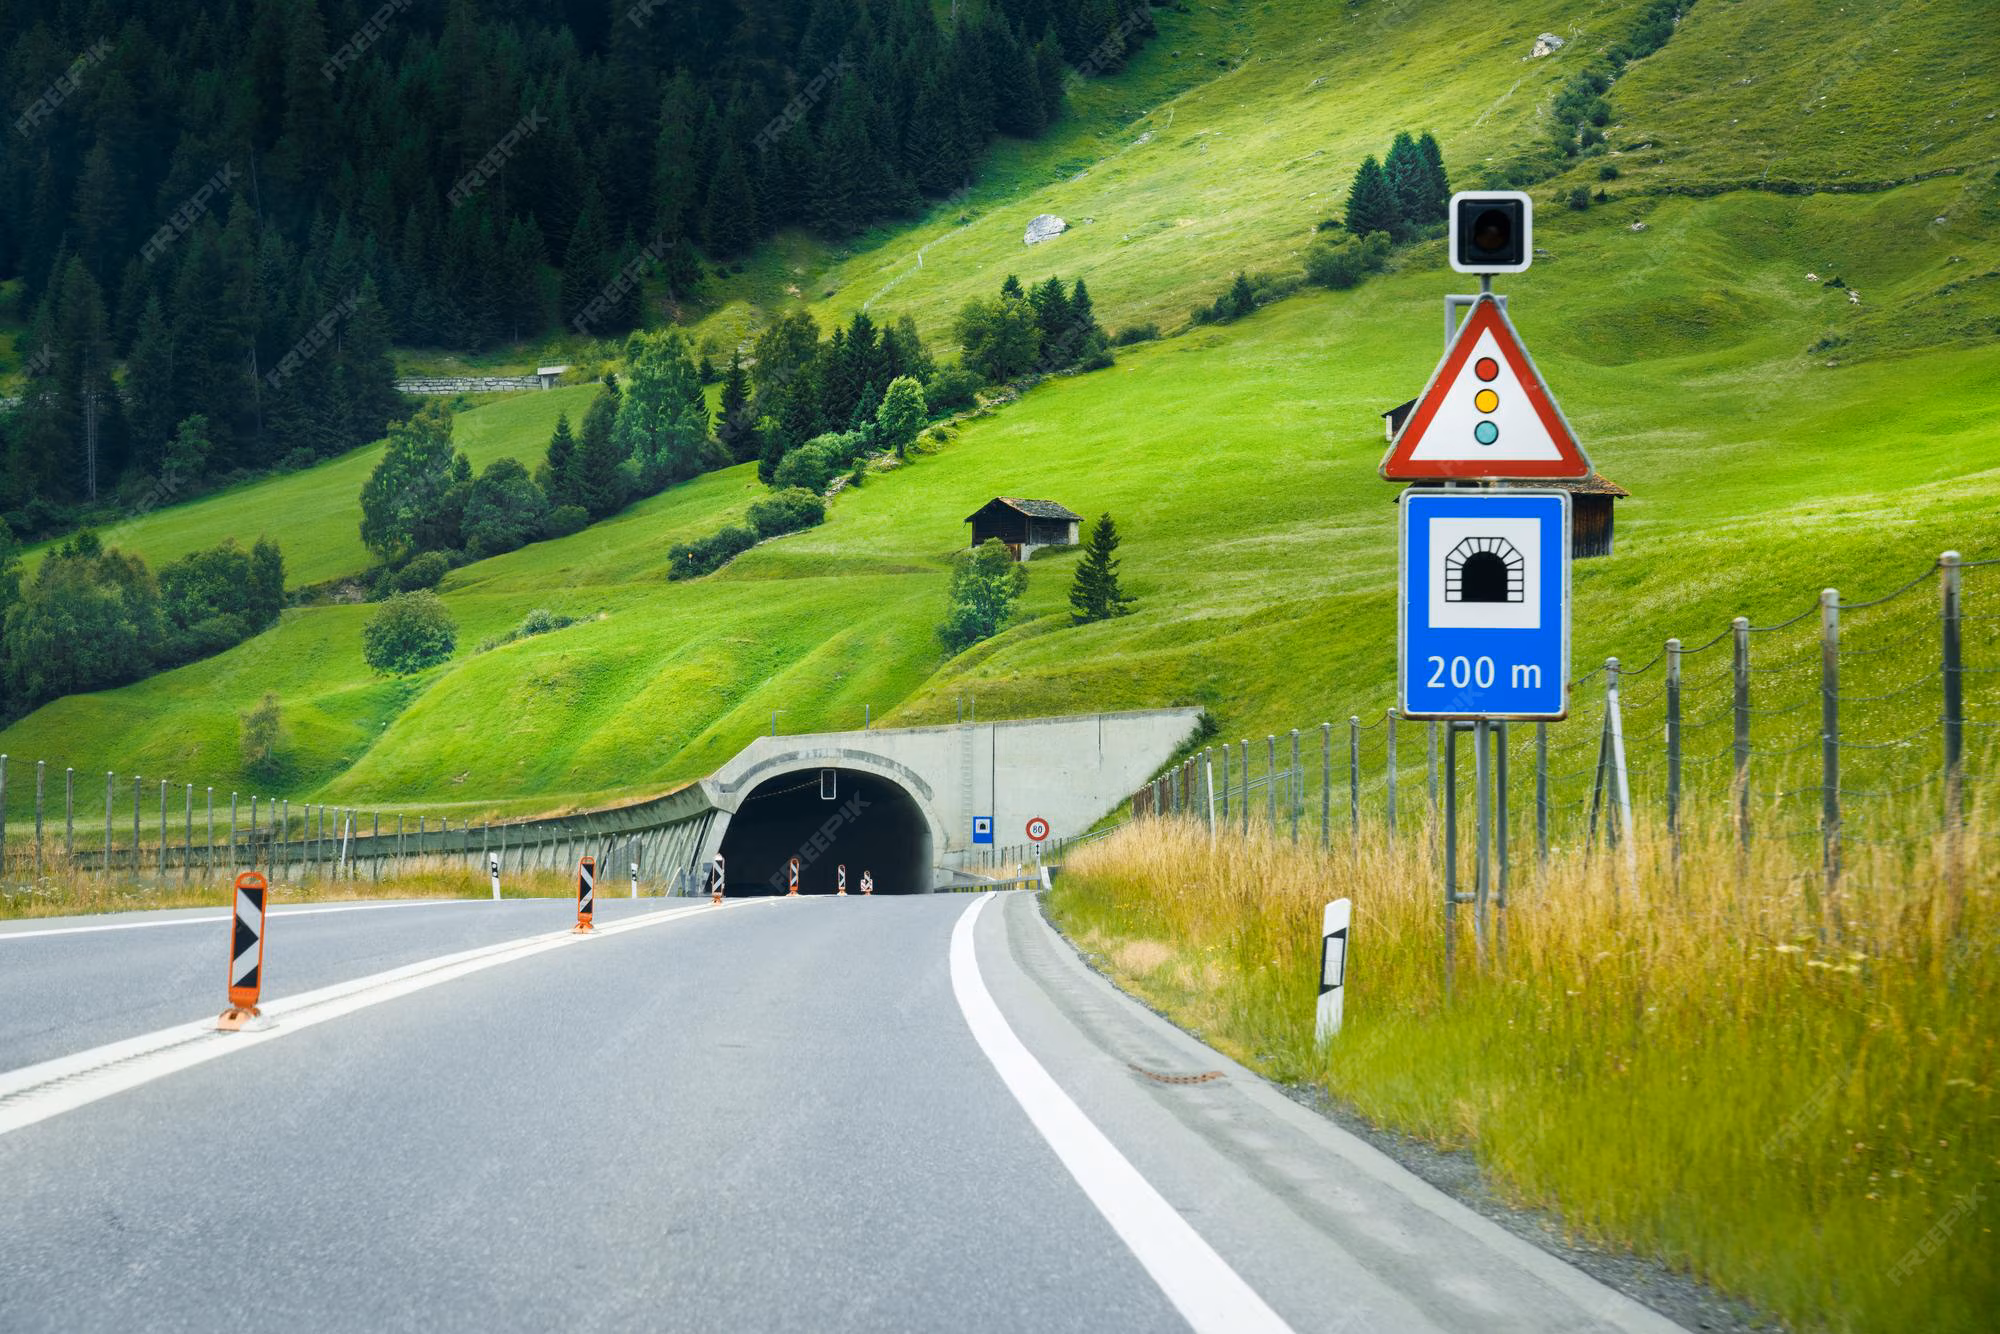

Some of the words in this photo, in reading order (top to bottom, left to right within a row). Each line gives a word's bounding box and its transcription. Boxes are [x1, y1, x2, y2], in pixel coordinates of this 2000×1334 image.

[1426, 655, 1495, 689] 200
[1511, 664, 1542, 689] m
[1032, 825, 1043, 834] 80
